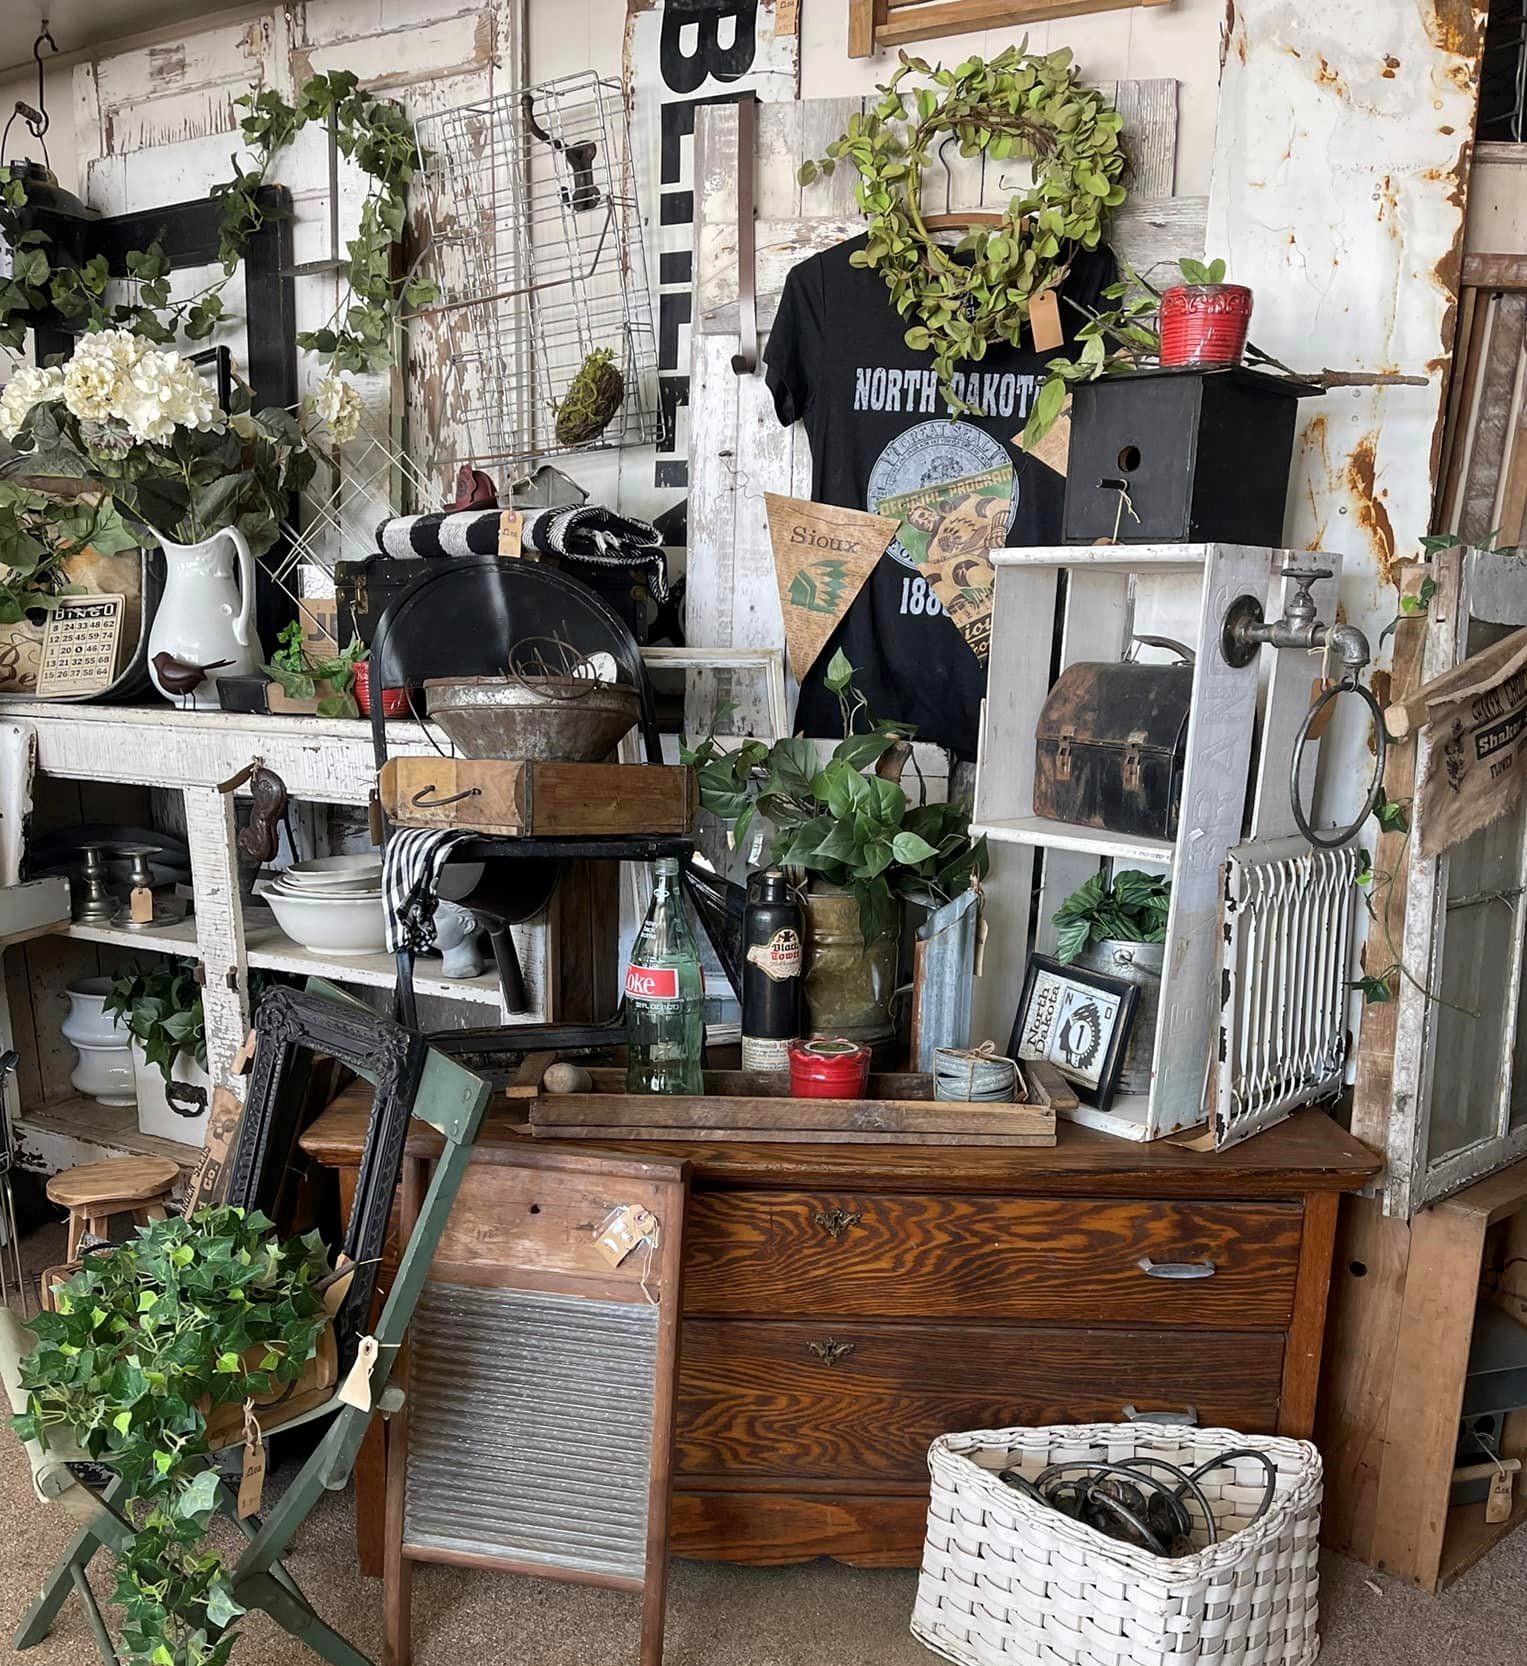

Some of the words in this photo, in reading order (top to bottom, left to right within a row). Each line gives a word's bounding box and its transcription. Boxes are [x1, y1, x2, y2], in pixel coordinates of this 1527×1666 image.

[854, 367, 938, 413] NORTH
[879, 491, 944, 516] OFFICIAL
[790, 525, 860, 553] Sioux
[900, 577, 951, 617] 188
[55, 604, 114, 620] BINGO
[1065, 991, 1074, 1005] N
[1026, 987, 1050, 1046] North
[1035, 985, 1060, 1055] Dakota
[1076, 1024, 1085, 1050] 1
